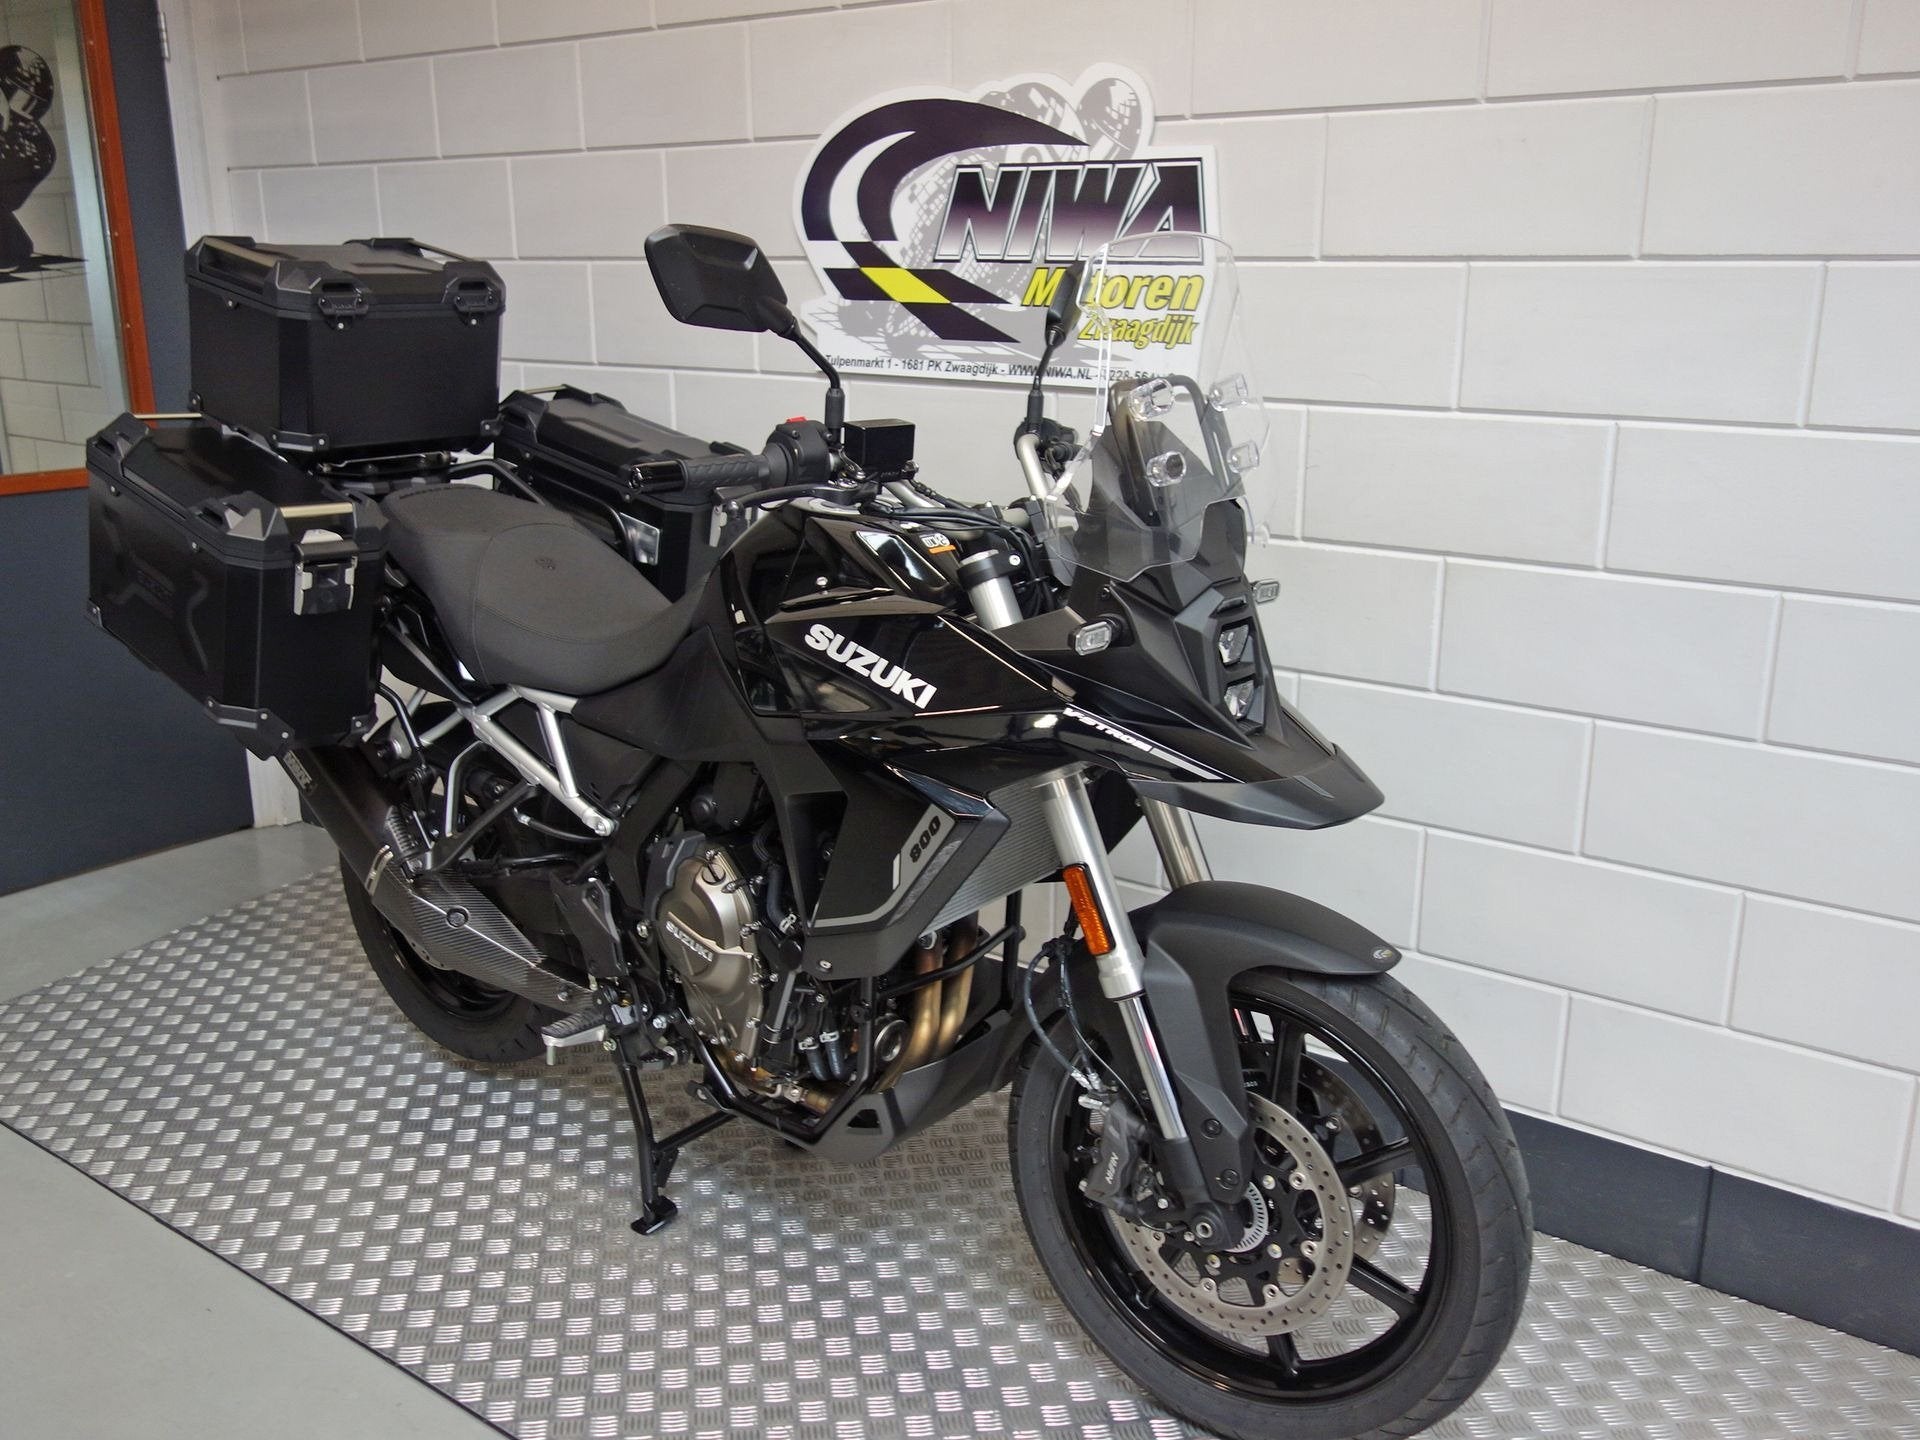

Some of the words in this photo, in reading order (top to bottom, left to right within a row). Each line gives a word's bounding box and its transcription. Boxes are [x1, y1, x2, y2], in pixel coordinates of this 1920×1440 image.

[933, 157, 1204, 265] NIWA
[1020, 266, 1205, 312] Mtoren
[826, 355, 884, 369] Tulpenmarkt
[886, 359, 892, 369] 1
[901, 360, 924, 371] 1681
[927, 361, 942, 372] PK
[945, 361, 998, 377] Zwaagdijk
[1008, 364, 1092, 380] WWWNIWA.NL
[804, 623, 937, 709] SUZUKI
[909, 815, 941, 863] 800
[665, 920, 715, 962] SUZUKI
